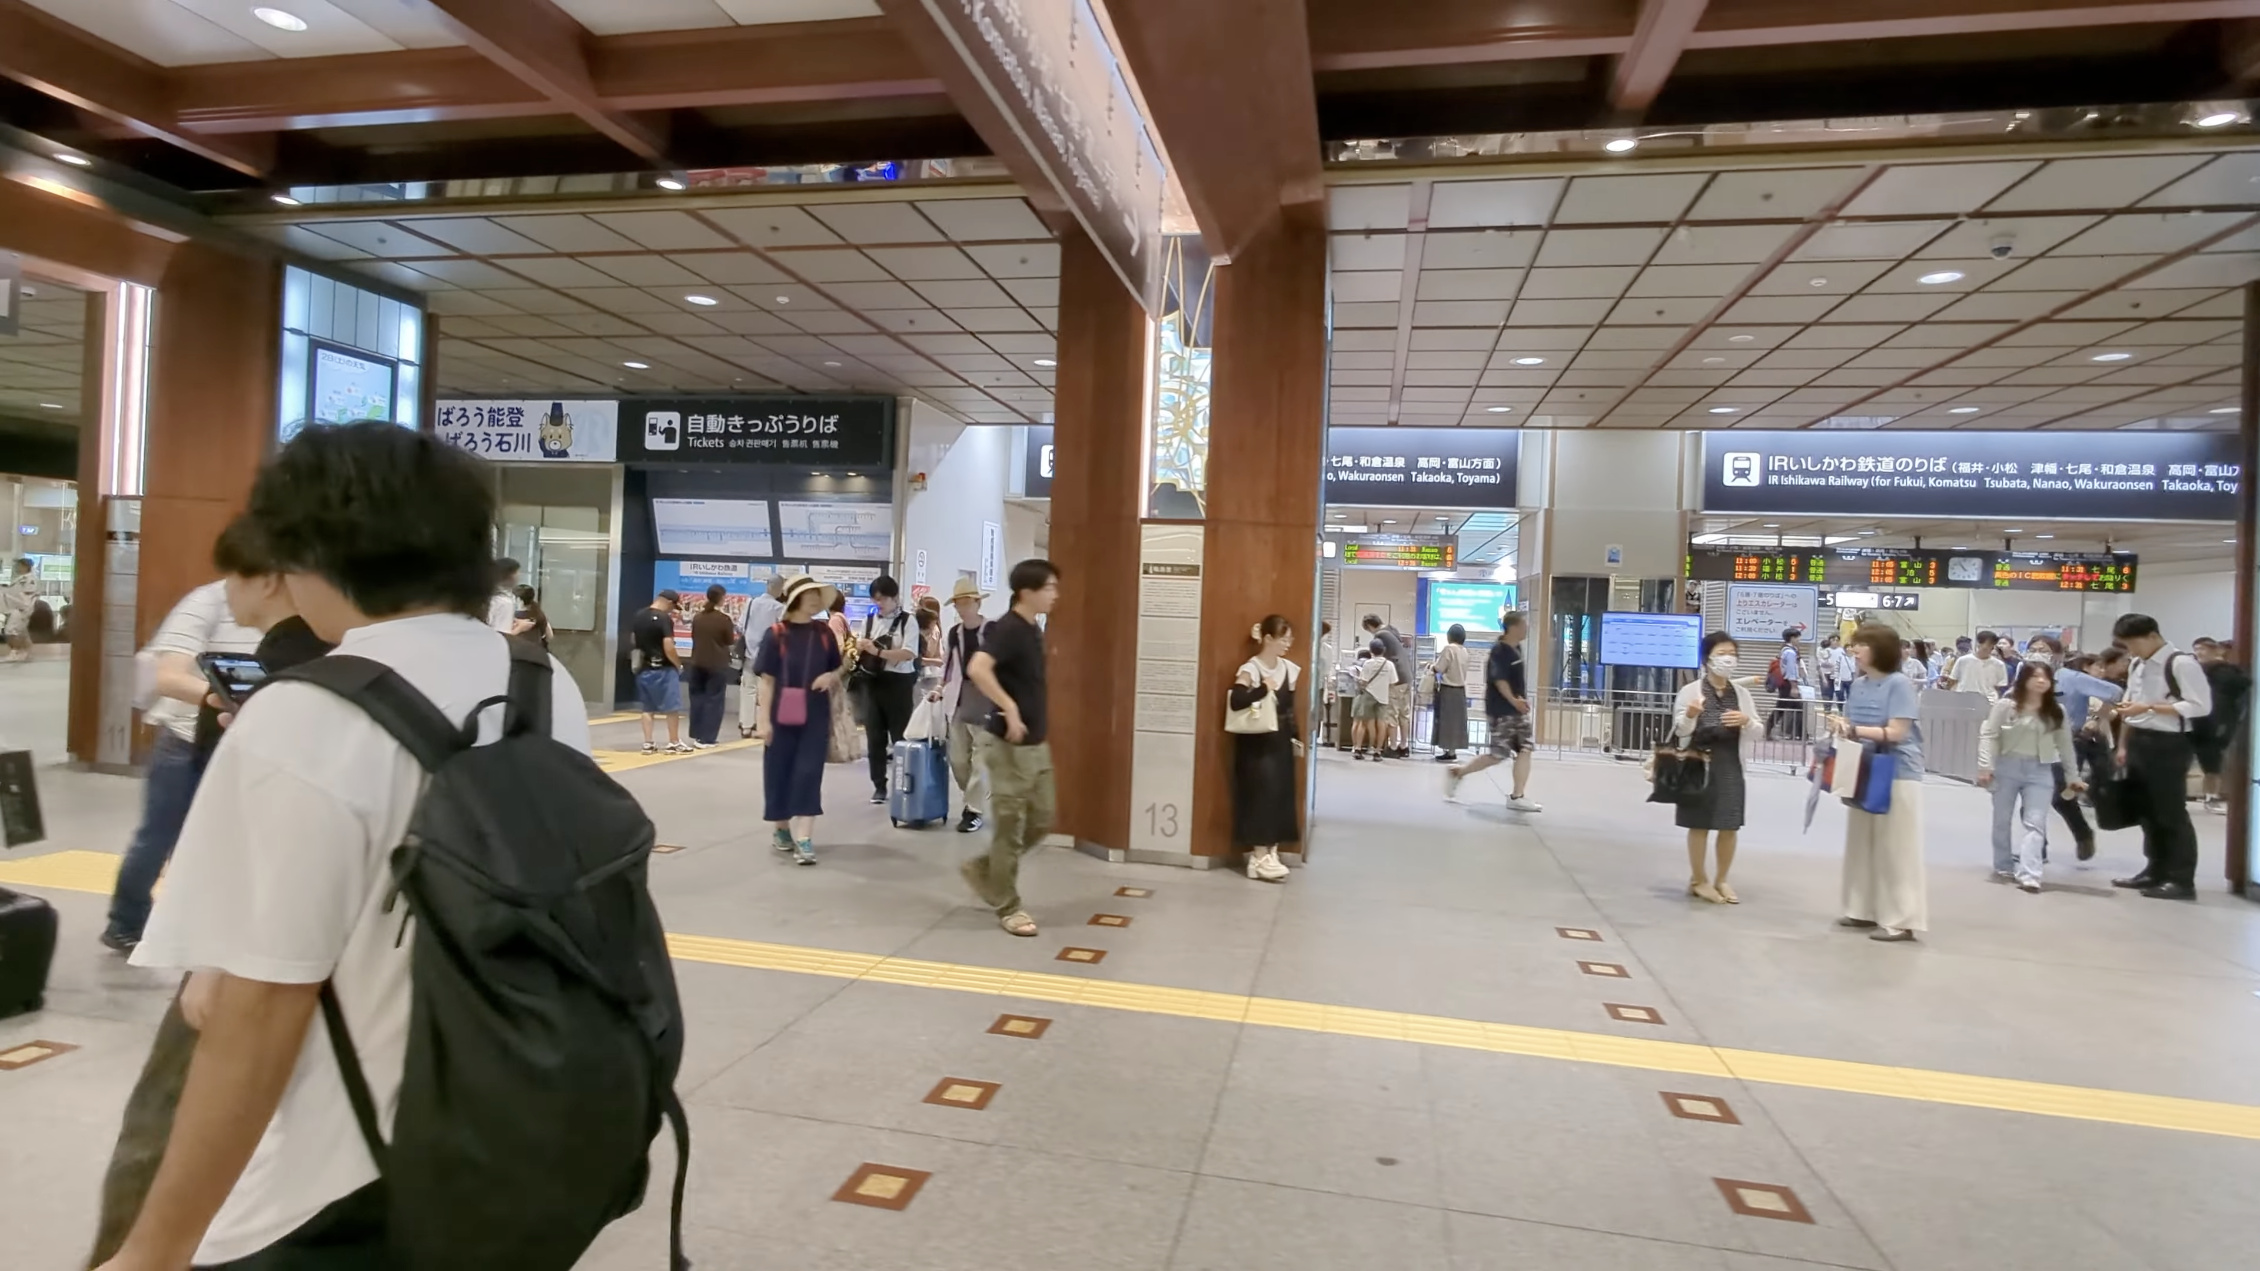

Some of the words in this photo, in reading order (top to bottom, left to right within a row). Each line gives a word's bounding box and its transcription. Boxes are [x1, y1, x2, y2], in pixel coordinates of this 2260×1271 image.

[687, 414, 840, 434] 自動きっぷうりば
[687, 436, 725, 448] Tickets
[1768, 455, 1948, 472] IRいしかわ鉄道のりば
[1338, 471, 1405, 482] Wakuraonsen
[1410, 471, 1455, 484] Takaoka,
[1456, 472, 1501, 486] Toyama)
[1768, 475, 1779, 486] IR
[1780, 475, 1826, 486] Ishikawa
[1828, 475, 1869, 488] Railway
[1871, 475, 1891, 488] (for
[1893, 476, 1926, 489] Fukui,
[1928, 477, 1977, 488] Komatsu
[1984, 477, 2030, 490] Tsubata,
[2032, 479, 2073, 490] Nanao,
[2074, 479, 2154, 491] Wakuraonsen
[2162, 480, 2214, 493] Takaoka,
[1144, 802, 1179, 838] 13
